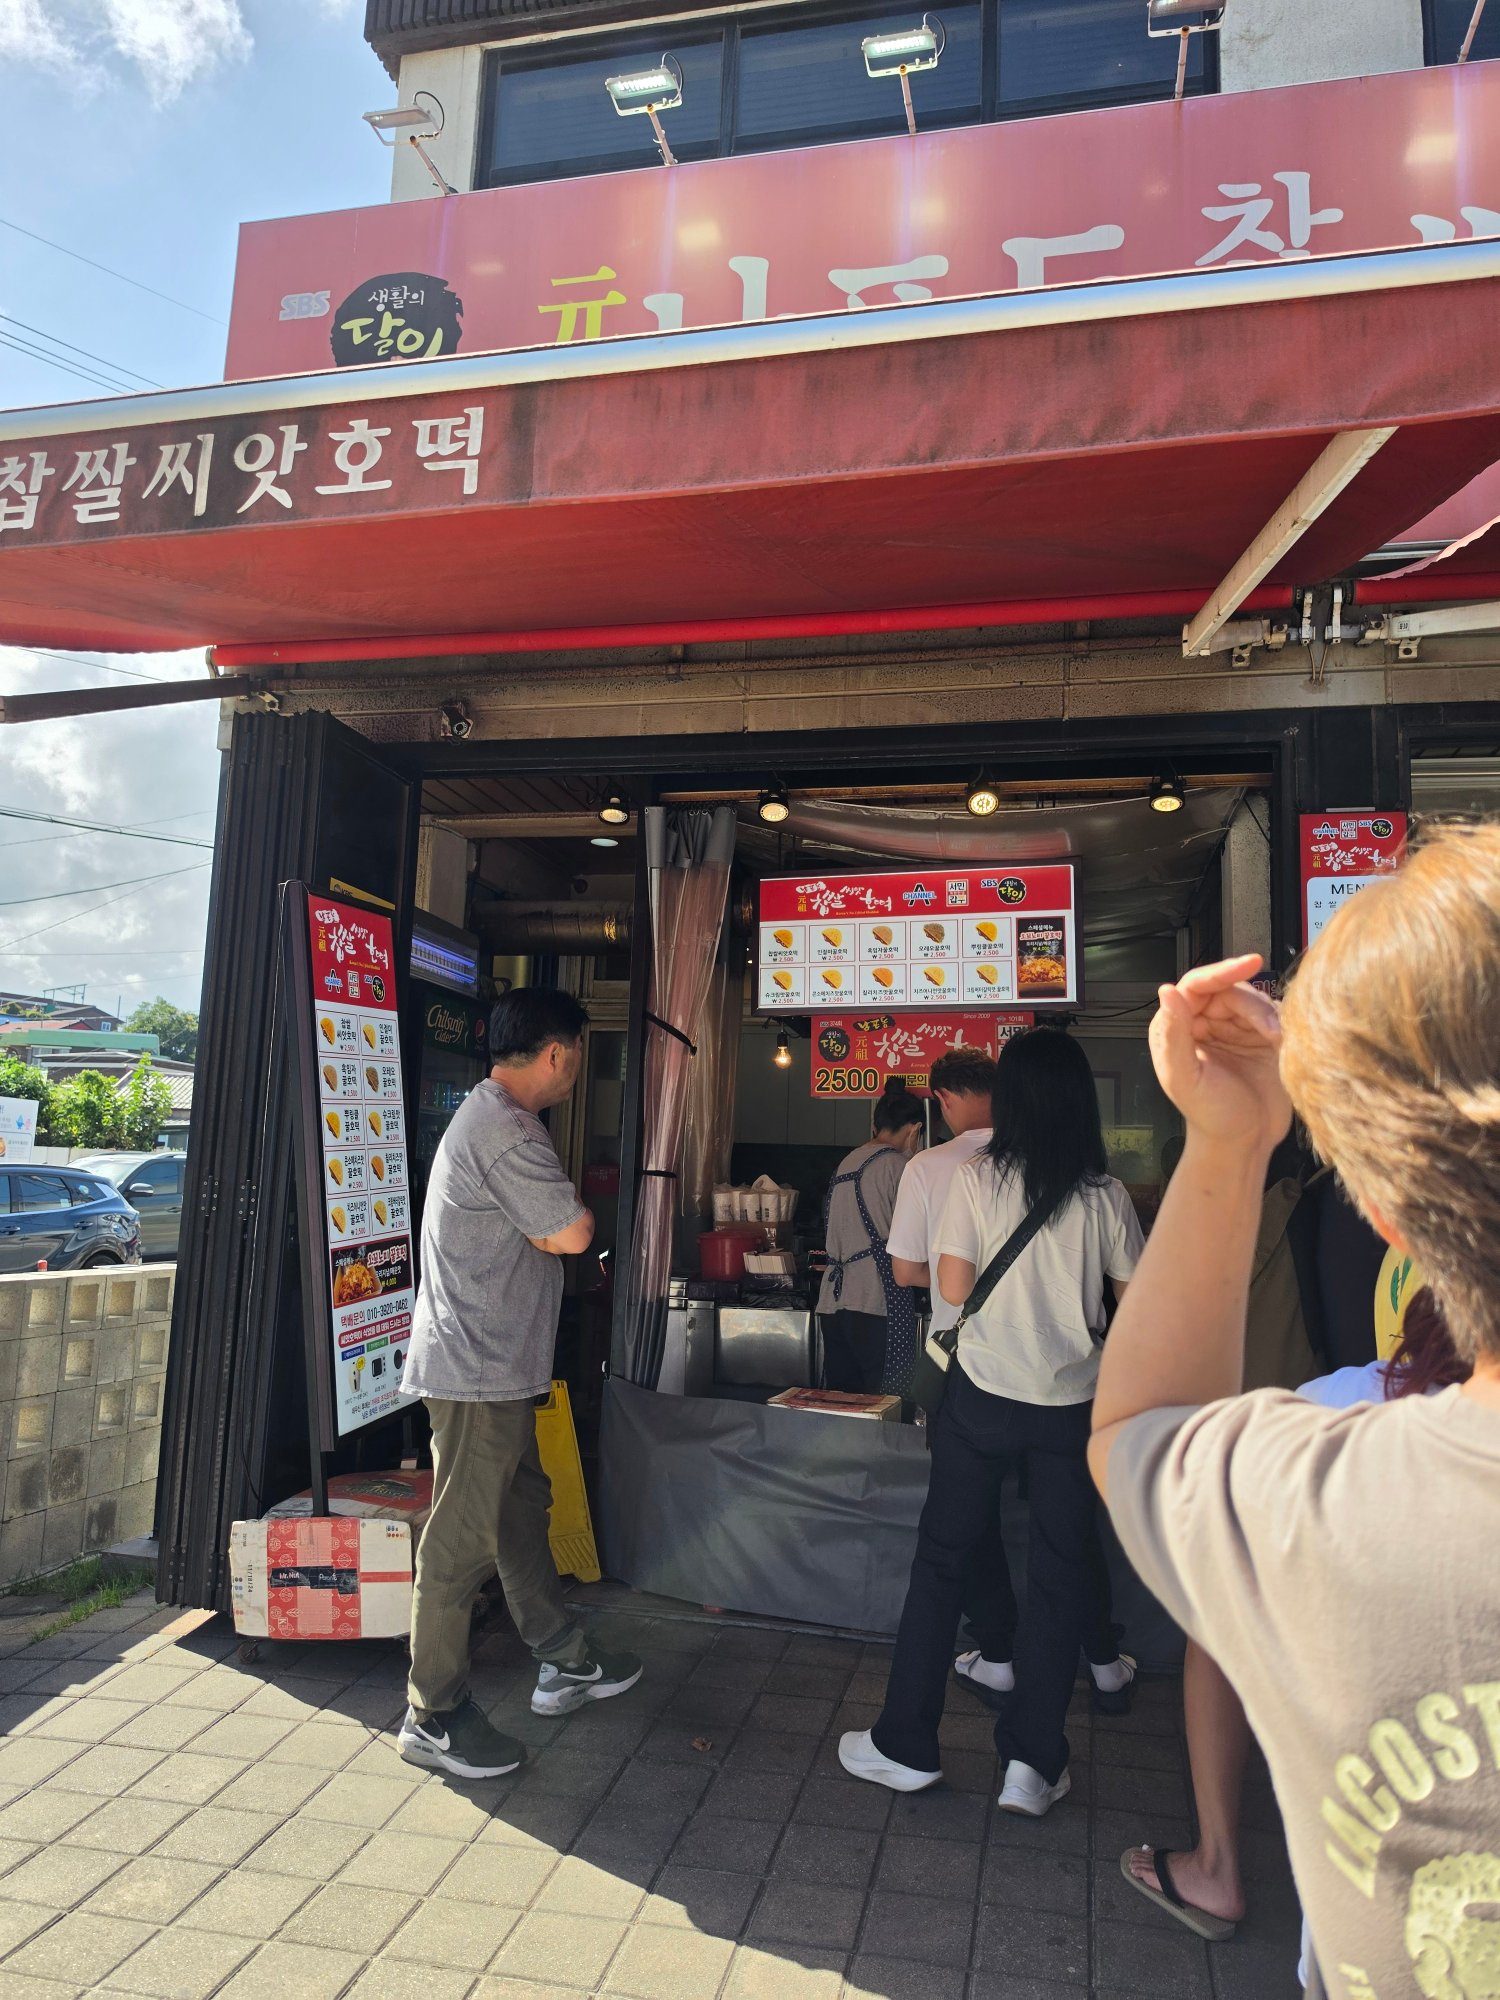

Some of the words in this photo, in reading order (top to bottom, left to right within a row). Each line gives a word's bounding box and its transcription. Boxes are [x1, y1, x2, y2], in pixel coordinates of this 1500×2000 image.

[279, 290, 331, 321] SBS
[368, 285, 424, 312] 생활의
[903, 892, 936, 900] CHANNEL
[949, 882, 965, 891] 서민
[981, 880, 998, 888] SBS
[999, 886, 1023, 900] 달인
[1331, 884, 1365, 895] MEN
[810, 889, 846, 916] 찹쌀
[840, 885, 864, 896] 씨앗
[328, 923, 357, 963] 찹쌀
[427, 1004, 465, 1036] Chilsung
[434, 1029, 456, 1044] Cider
[820, 1039, 846, 1057] 달인
[856, 1035, 868, 1060] 元祖
[873, 1028, 925, 1068] 찹쌀
[917, 1023, 952, 1038] 씨앗
[815, 1067, 880, 1093] 2500
